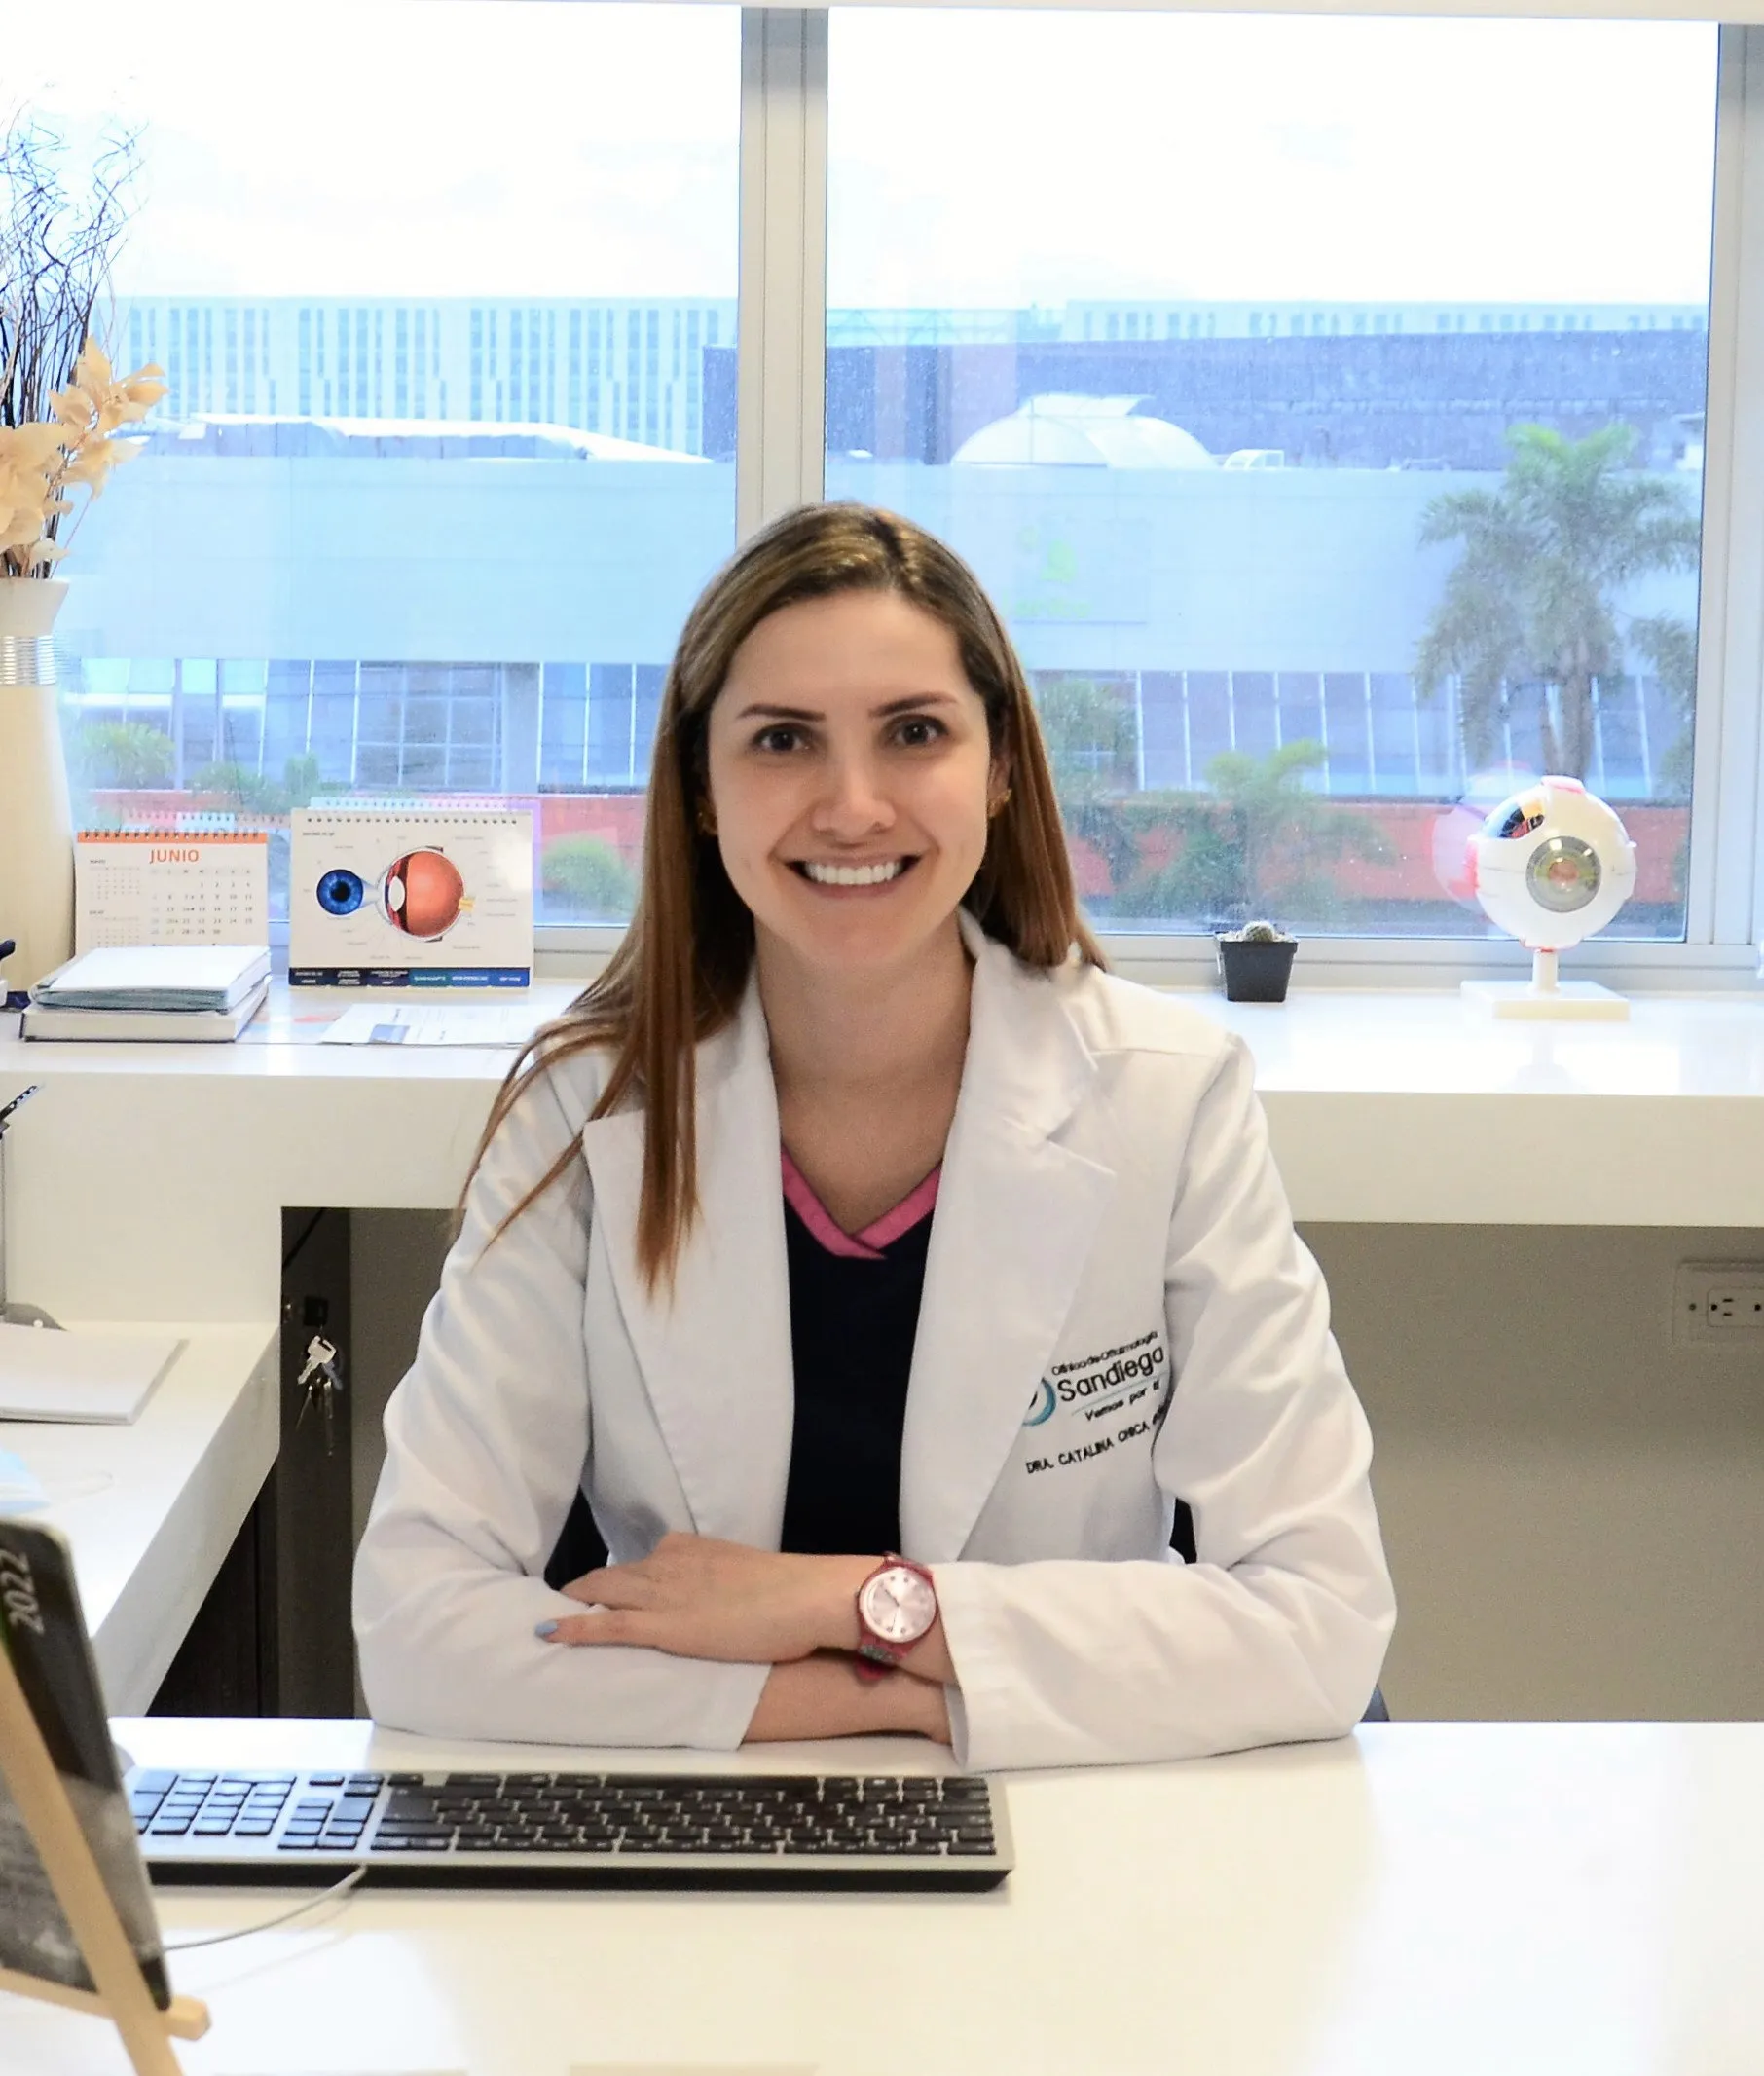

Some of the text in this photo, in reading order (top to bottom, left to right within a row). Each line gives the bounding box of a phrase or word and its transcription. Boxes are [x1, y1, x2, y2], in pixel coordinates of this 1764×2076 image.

[149, 849, 200, 865] JUNIO
[1057, 1346, 1164, 1402] Sandiego
[1025, 1458, 1055, 1474] DRA.
[1058, 1437, 1115, 1465] CATALINA
[0, 1547, 45, 1635] 2022
